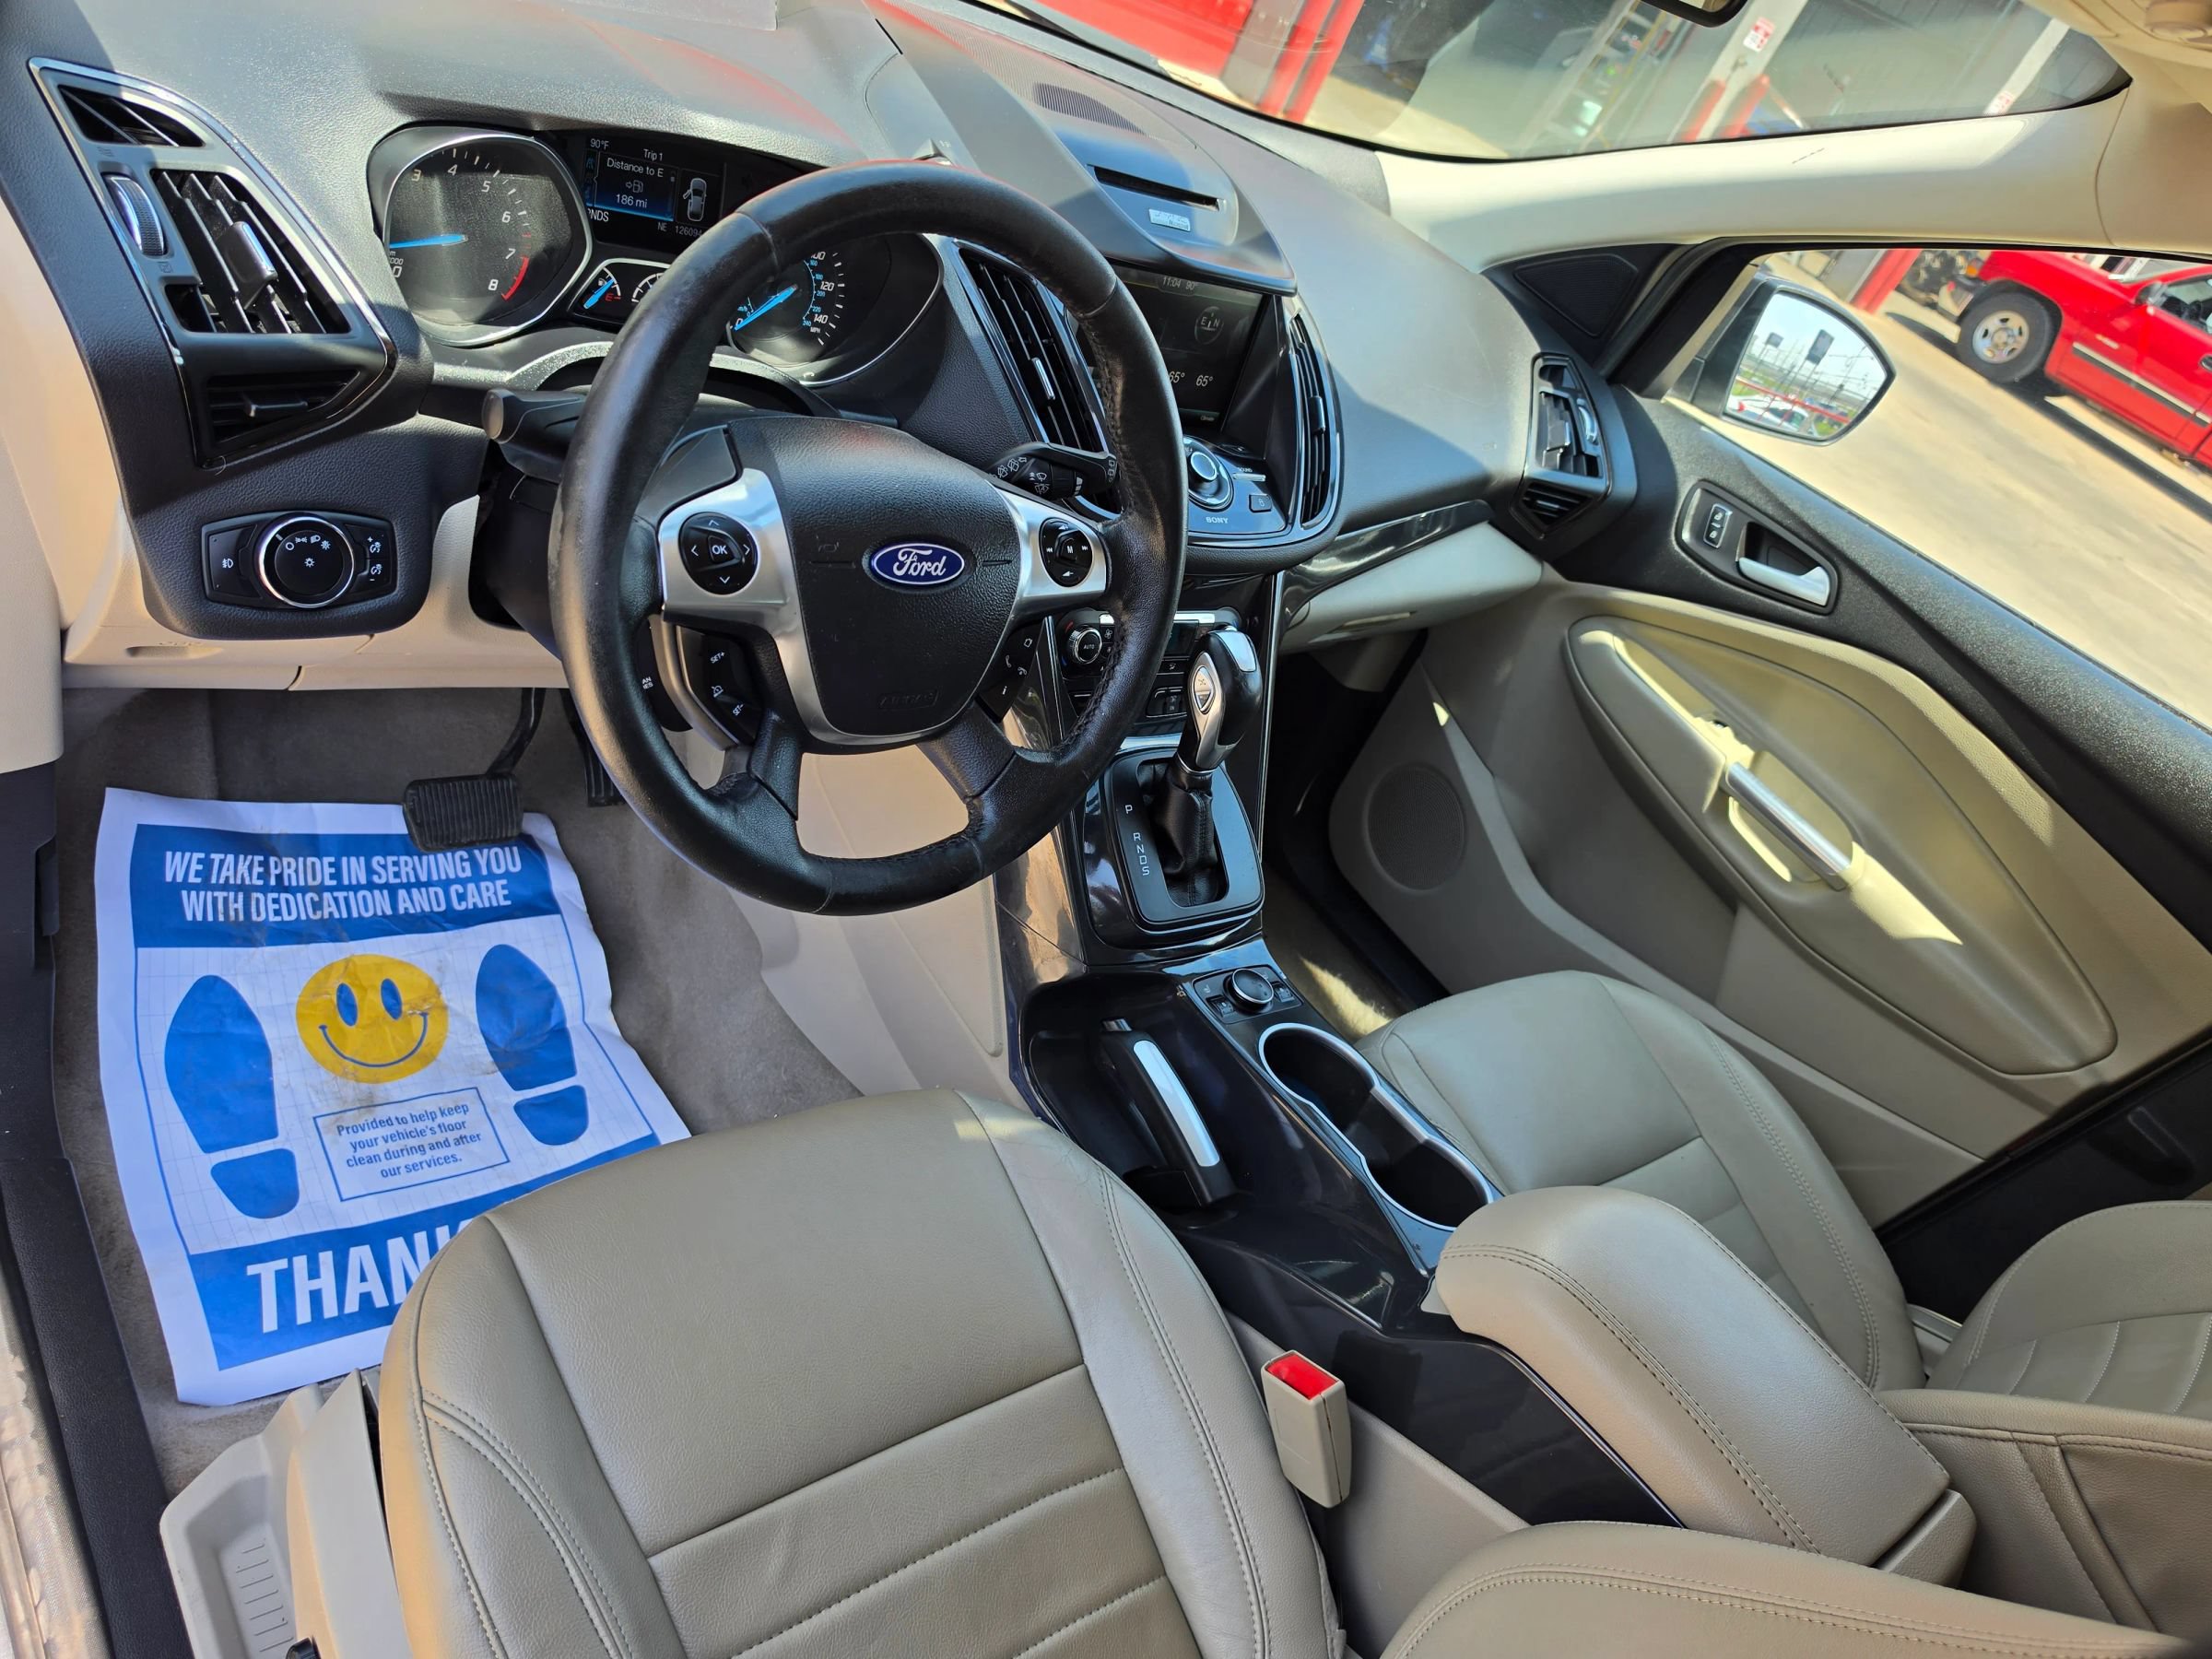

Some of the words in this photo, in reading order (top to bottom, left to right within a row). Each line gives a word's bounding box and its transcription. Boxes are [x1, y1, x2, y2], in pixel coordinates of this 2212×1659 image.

[590, 138, 609, 150] 90°F
[643, 148, 657, 161] Trip
[659, 152, 664, 161] 1
[448, 164, 458, 176] 4
[606, 158, 644, 174] Distance
[646, 166, 655, 176] to
[657, 168, 665, 178] E
[411, 168, 422, 182] 3
[481, 181, 491, 193] 5
[616, 194, 634, 206] 186
[635, 197, 648, 208] mi
[501, 211, 511, 223] 6
[657, 222, 667, 231] NE
[505, 248, 516, 260] 7
[488, 278, 499, 291] 8
[819, 280, 835, 292] 120
[1162, 276, 1182, 288] 11:04
[605, 292, 614, 302] E
[813, 313, 829, 324] 140
[1201, 316, 1207, 325] E
[1213, 318, 1220, 327] N
[1195, 375, 1214, 387] 65°
[1206, 516, 1229, 524] SONY
[712, 545, 728, 555] OK
[1066, 545, 1074, 554] M
[892, 547, 947, 576] Ford
[710, 651, 725, 664] SET+
[1124, 805, 1133, 815] P
[1133, 832, 1141, 841] R
[1136, 843, 1145, 853] N
[1139, 855, 1147, 865] D
[164, 851, 205, 884] WE
[209, 853, 265, 886] TAKE
[269, 855, 337, 887] PRIDE
[341, 855, 367, 886] IN
[371, 850, 472, 885] SERVING
[474, 846, 523, 876] YOU
[1142, 866, 1150, 876] S
[181, 889, 244, 922] WITH
[251, 889, 393, 922] DEDICATION
[397, 886, 447, 914] AND
[450, 878, 512, 912] CARE
[336, 1115, 394, 1136] Provided
[394, 1114, 408, 1125] to
[410, 1109, 438, 1124] help
[439, 1103, 470, 1119] keep
[349, 1136, 379, 1153] your
[382, 1125, 437, 1144] vehicle's
[438, 1119, 467, 1135] floor
[346, 1152, 382, 1168] clean
[383, 1143, 427, 1161] during
[429, 1137, 452, 1151] and
[453, 1132, 482, 1147] after
[380, 1165, 402, 1179] our
[406, 1152, 463, 1173] services.
[246, 1218, 474, 1335] THAN
